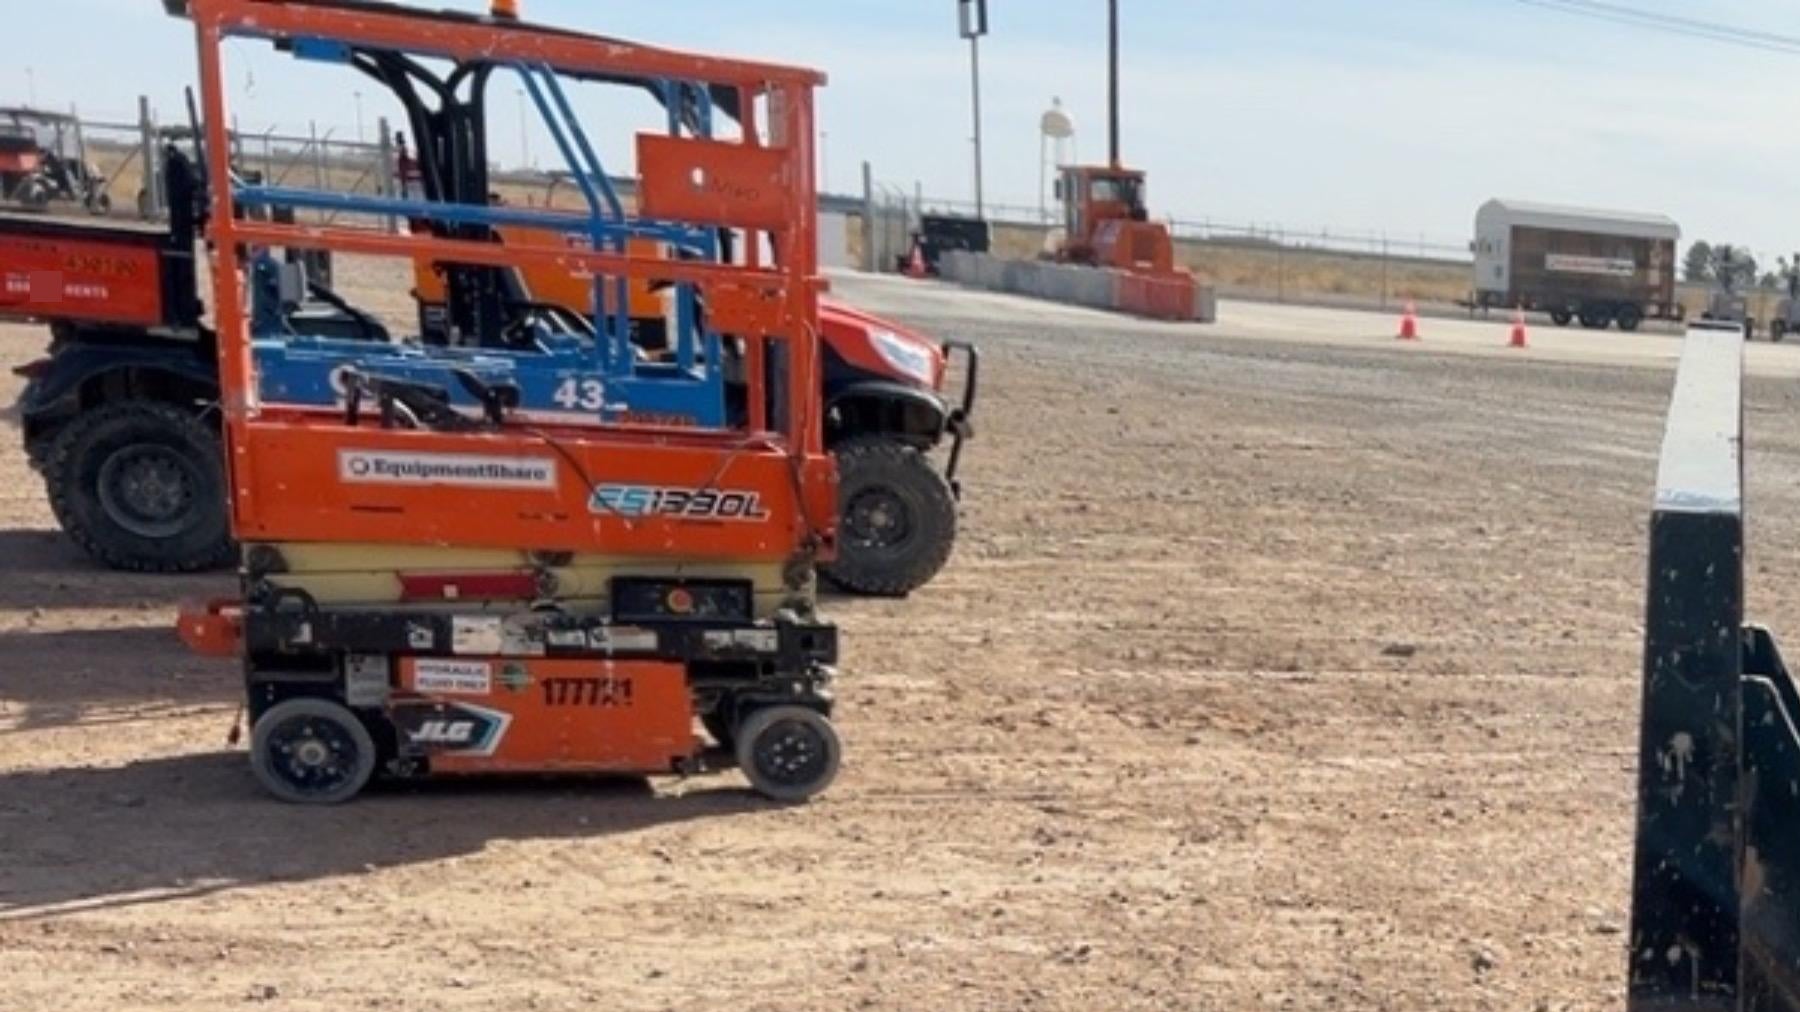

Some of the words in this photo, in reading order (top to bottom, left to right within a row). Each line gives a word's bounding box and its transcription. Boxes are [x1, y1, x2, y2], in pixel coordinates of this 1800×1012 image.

[373, 458, 547, 481] EquipmentShare
[589, 483, 771, 521] ES1330L
[410, 720, 474, 742] JLG
